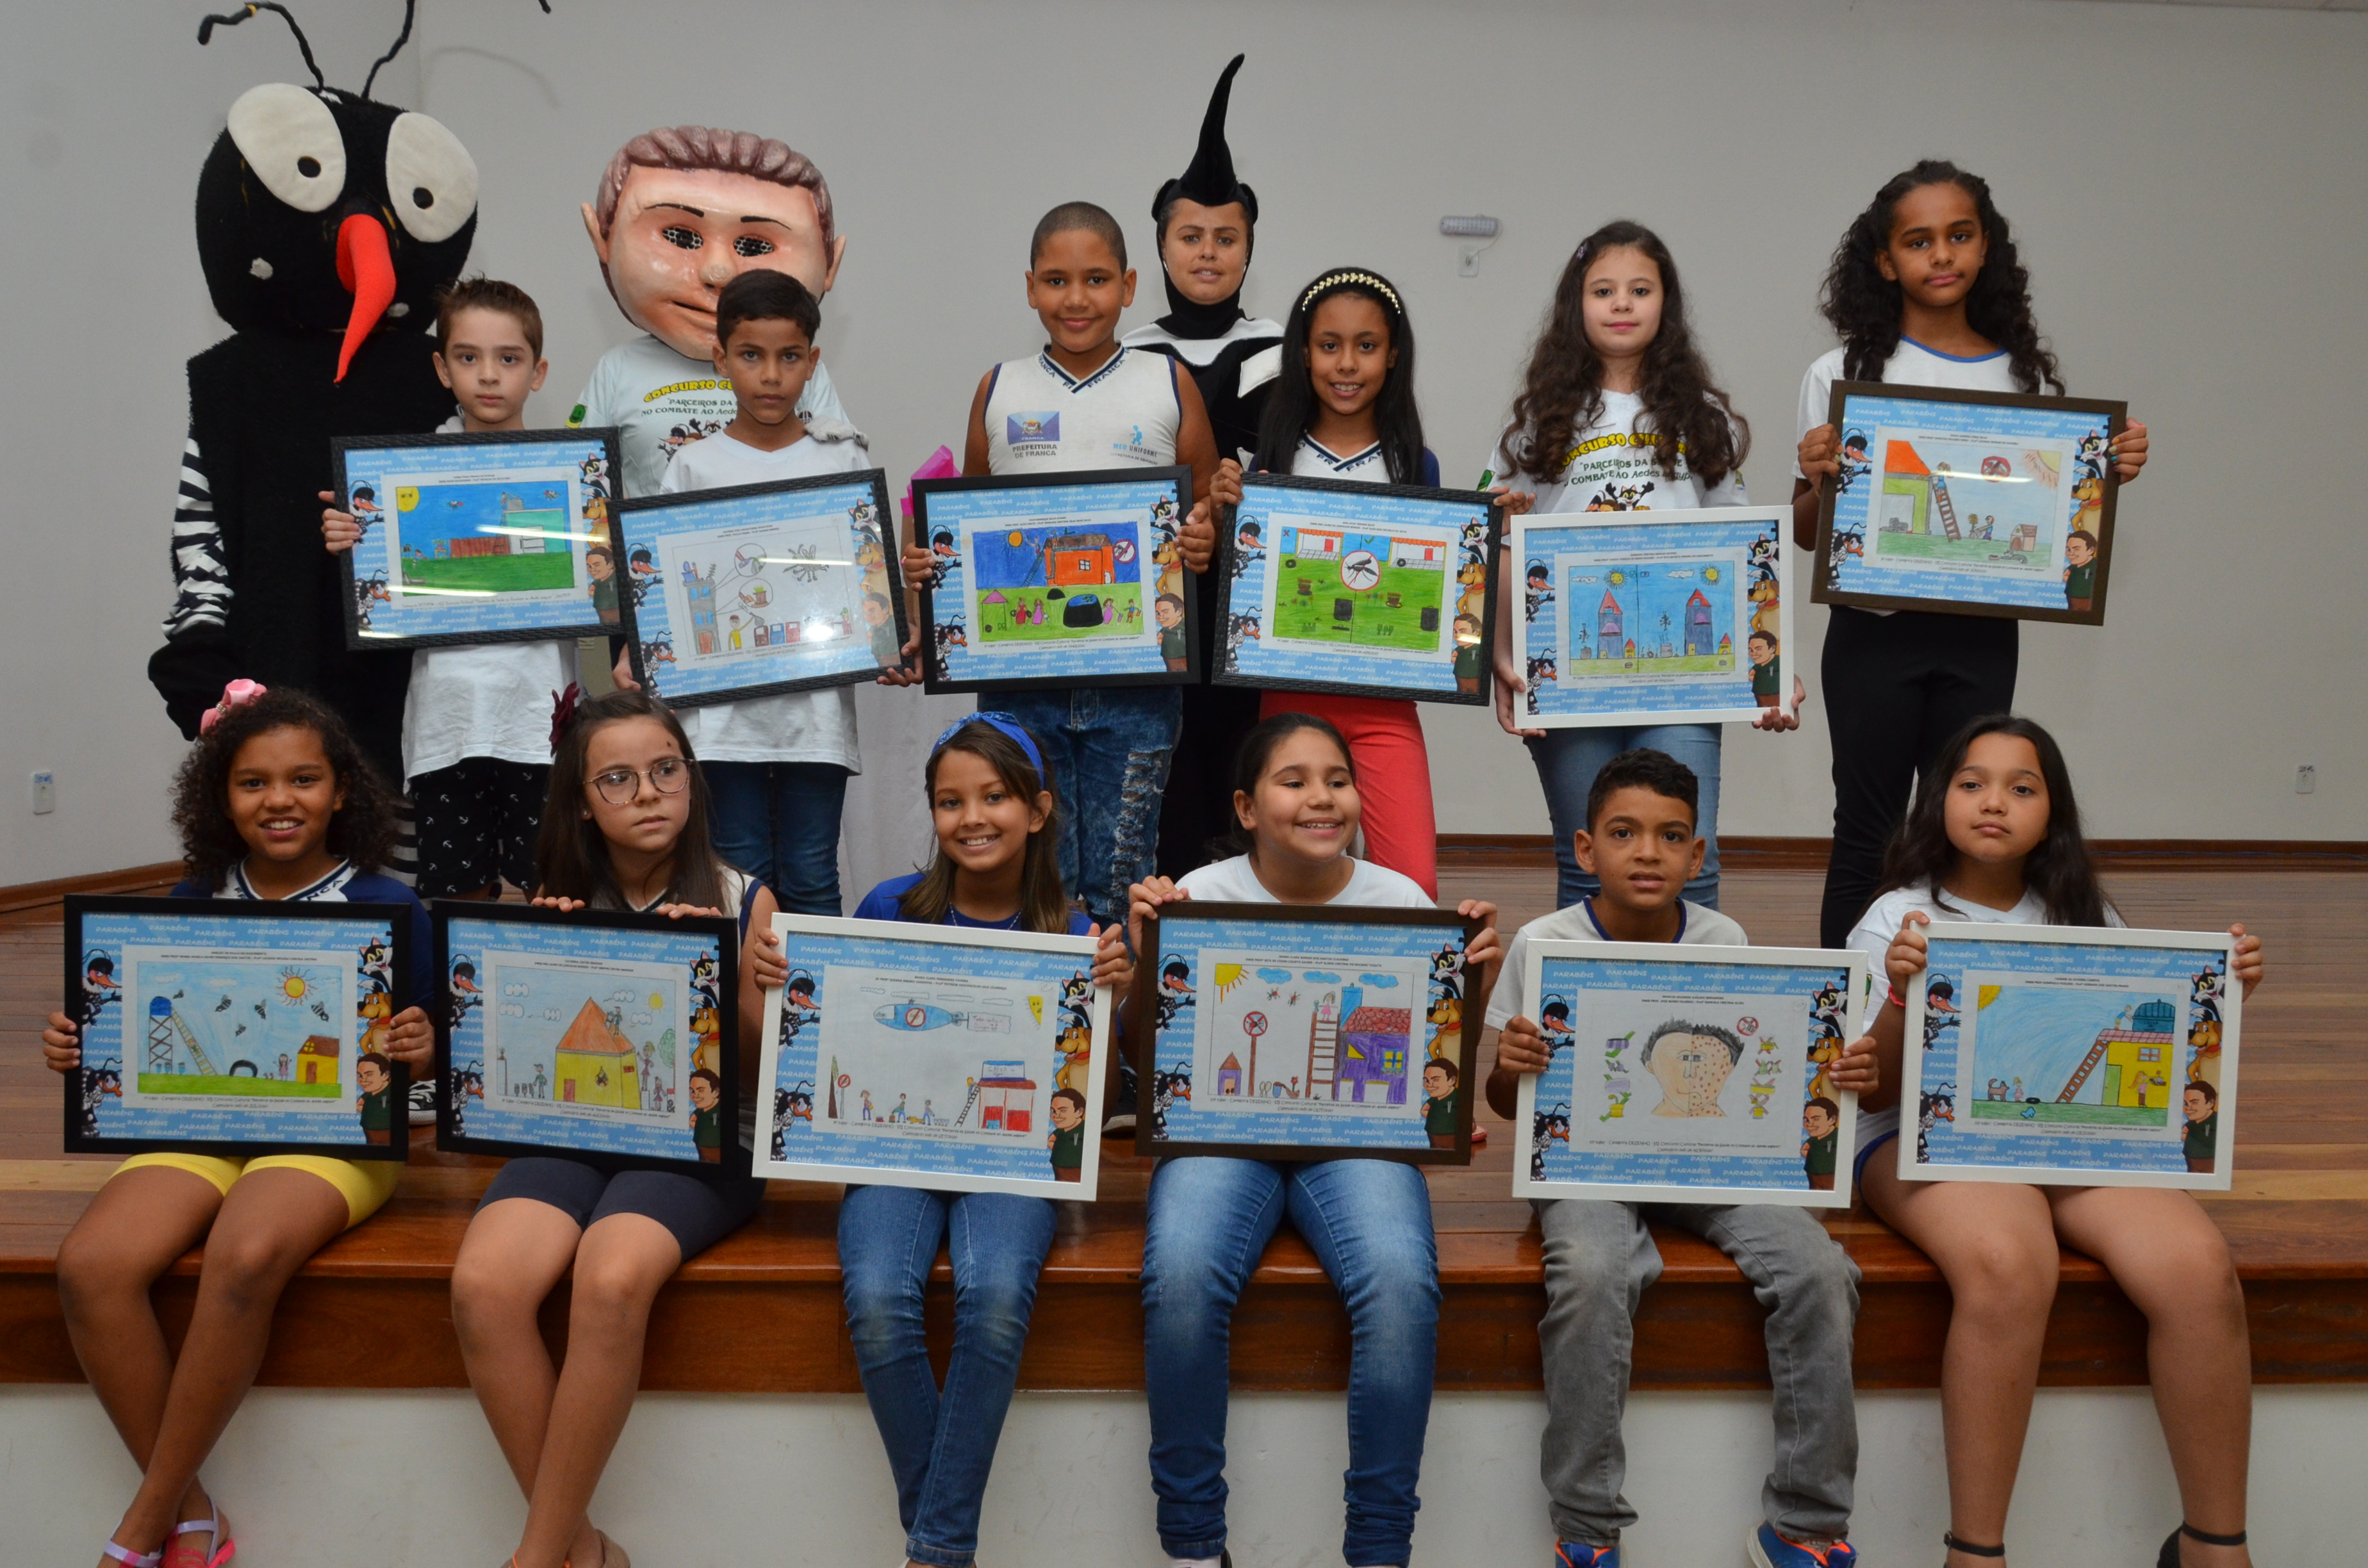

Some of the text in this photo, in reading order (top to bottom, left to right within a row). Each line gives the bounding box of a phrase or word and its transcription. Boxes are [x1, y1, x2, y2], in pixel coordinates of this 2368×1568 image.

[1087, 359, 1126, 388] FRANCA
[643, 380, 716, 402] CONCURSO
[641, 409, 652, 417] NO
[1012, 444, 1057, 452] PREFEITURA
[1129, 446, 1158, 457] UNIFORME
[1558, 433, 1627, 474] ONCURSO
[1635, 459, 1648, 467] DA
[1572, 470, 1615, 485] COMBATE
[1632, 469, 1660, 478] Aedes
[953, 956, 993, 964] PARABÉNS
